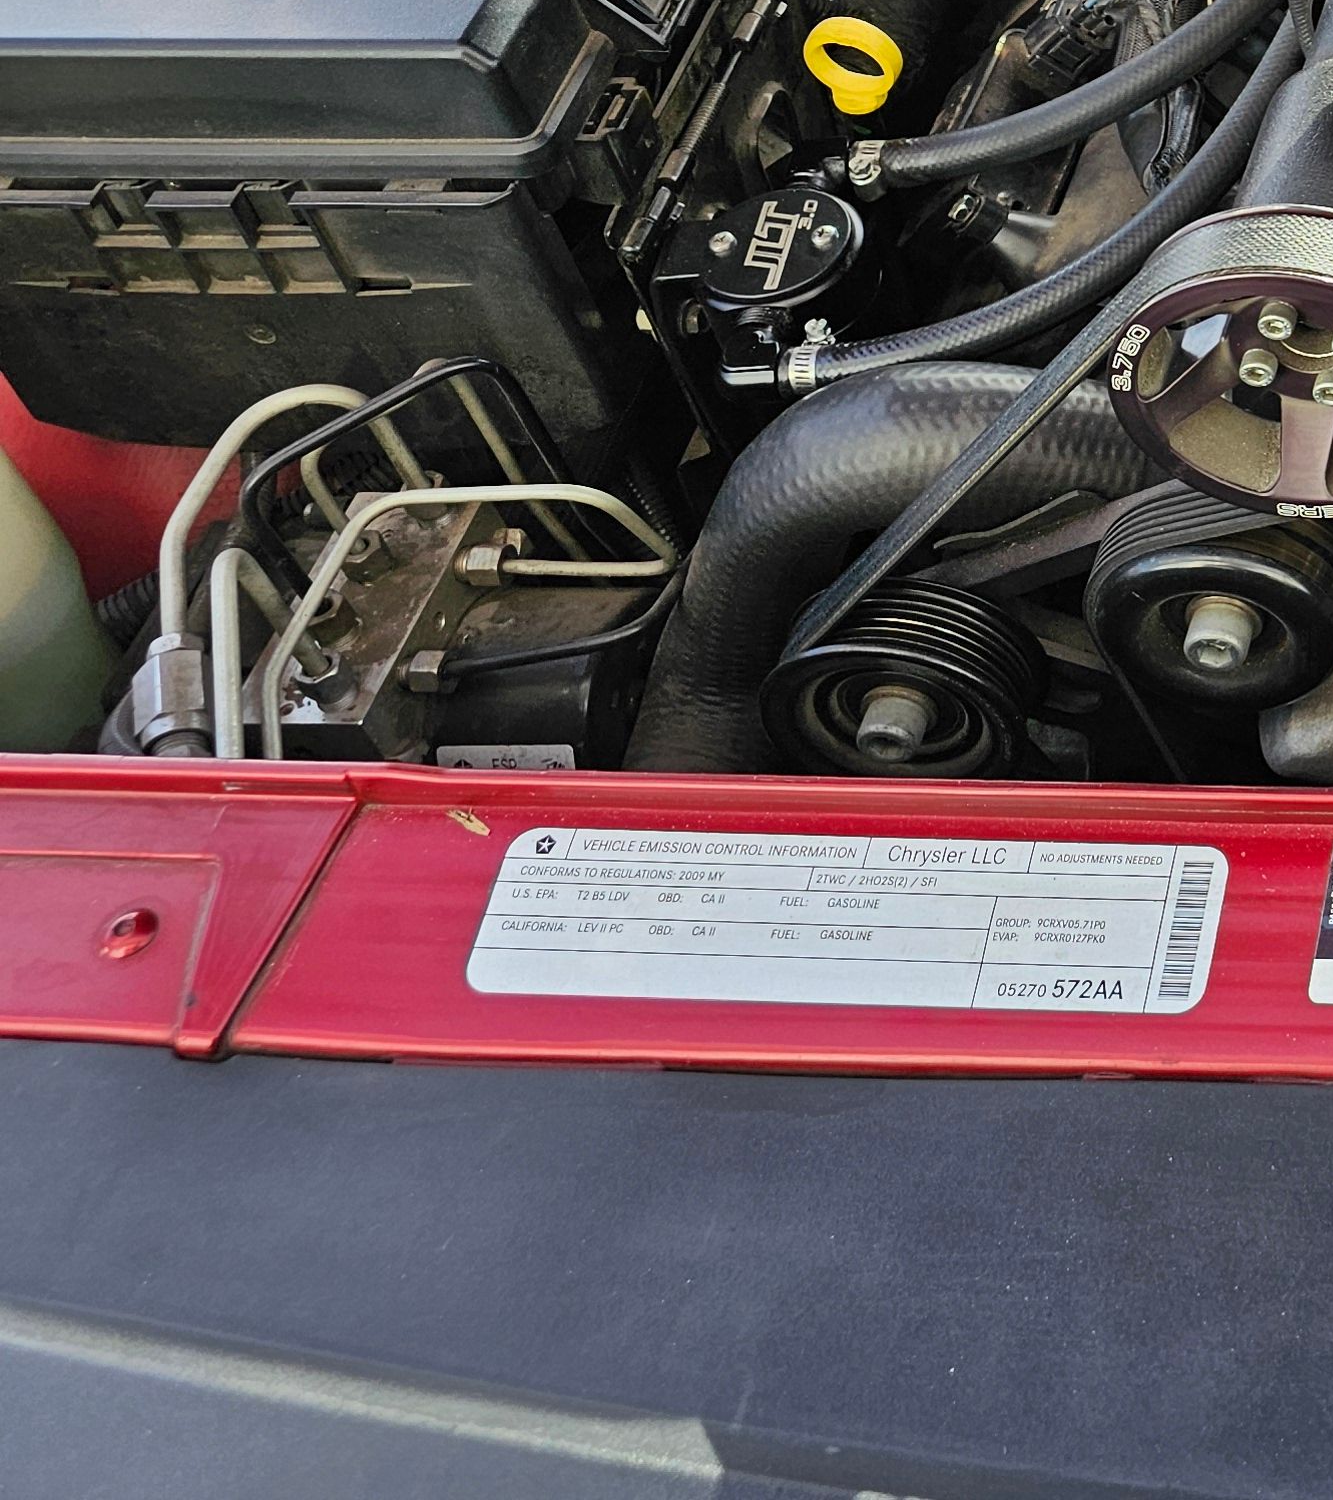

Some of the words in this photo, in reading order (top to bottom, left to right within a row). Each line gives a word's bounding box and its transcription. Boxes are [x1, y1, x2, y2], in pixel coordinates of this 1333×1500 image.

[797, 199, 819, 230] 3.0
[743, 200, 800, 291] JLT
[1112, 323, 1152, 393] 3.750
[583, 838, 637, 852] VEHICLE
[637, 840, 702, 854] EMISSION
[704, 842, 764, 856] CONTROL
[767, 844, 857, 858] INFORMATION
[887, 844, 967, 867] Chrysler
[970, 846, 1007, 865] LLC
[1055, 852, 1123, 864] ADJUSTMENTS
[1124, 854, 1163, 865] NEEDED
[519, 864, 581, 877] CONFORMS
[599, 867, 676, 880] REGULATIONS:
[677, 869, 705, 881] 2009
[815, 873, 846, 885] 2TWC
[919, 876, 938, 887] SFI
[511, 887, 531, 899] U.S.
[534, 887, 558, 899] EPA:
[607, 890, 630, 901] LDV
[656, 891, 682, 903] OBD:
[779, 895, 809, 907] FUEL:
[826, 896, 880, 909] GASOLINE
[500, 919, 567, 932] CALIFORNIA:
[576, 921, 599, 933] LEV
[647, 924, 673, 936] OBD:
[769, 928, 800, 940] FUEL:
[819, 928, 873, 941] GASOLINE
[994, 917, 1031, 928] GROUP:
[991, 930, 1018, 942] EVAP:
[996, 982, 1047, 997] 05270
[1051, 978, 1123, 1000] 572AA
